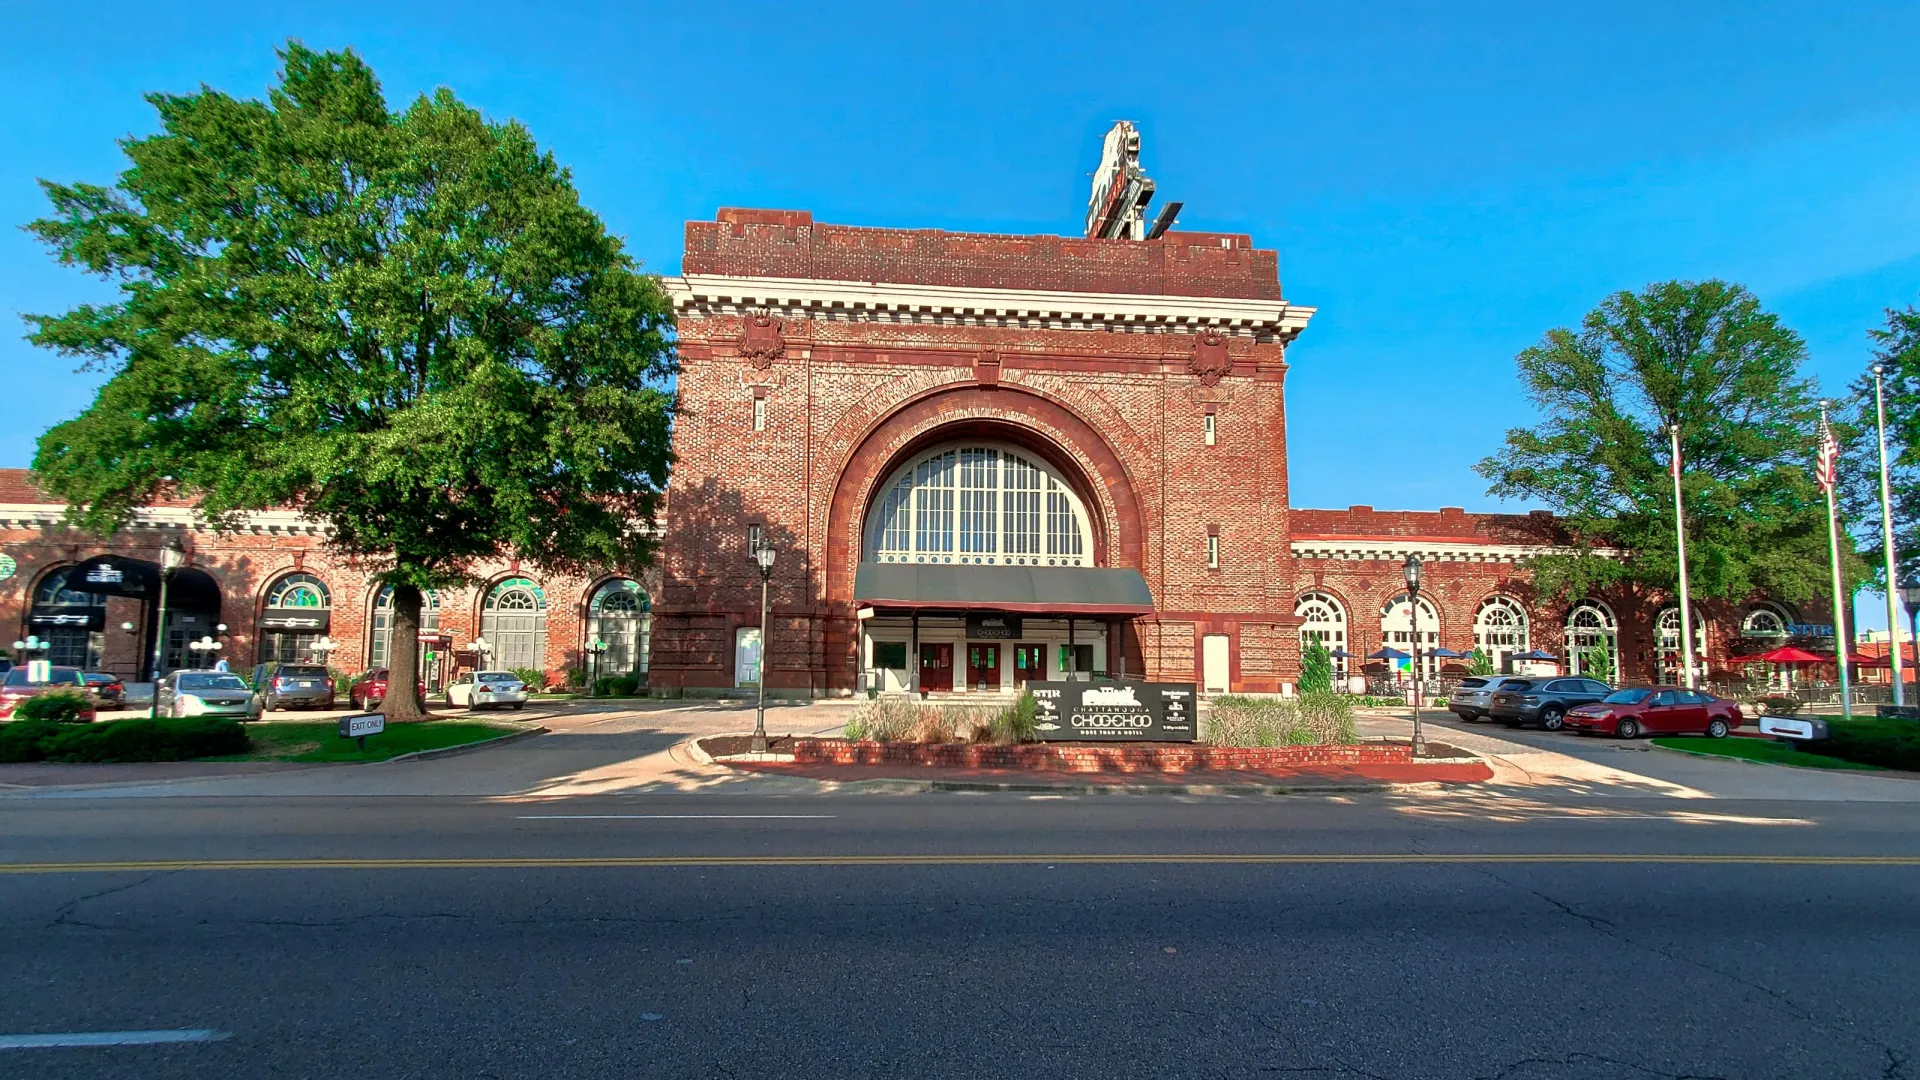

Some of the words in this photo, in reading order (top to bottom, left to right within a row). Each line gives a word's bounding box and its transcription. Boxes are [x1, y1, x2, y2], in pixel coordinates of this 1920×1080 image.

[1032, 689, 1061, 698] STIR
[351, 721, 365, 731] EXIT
[366, 719, 383, 729] ONLY
